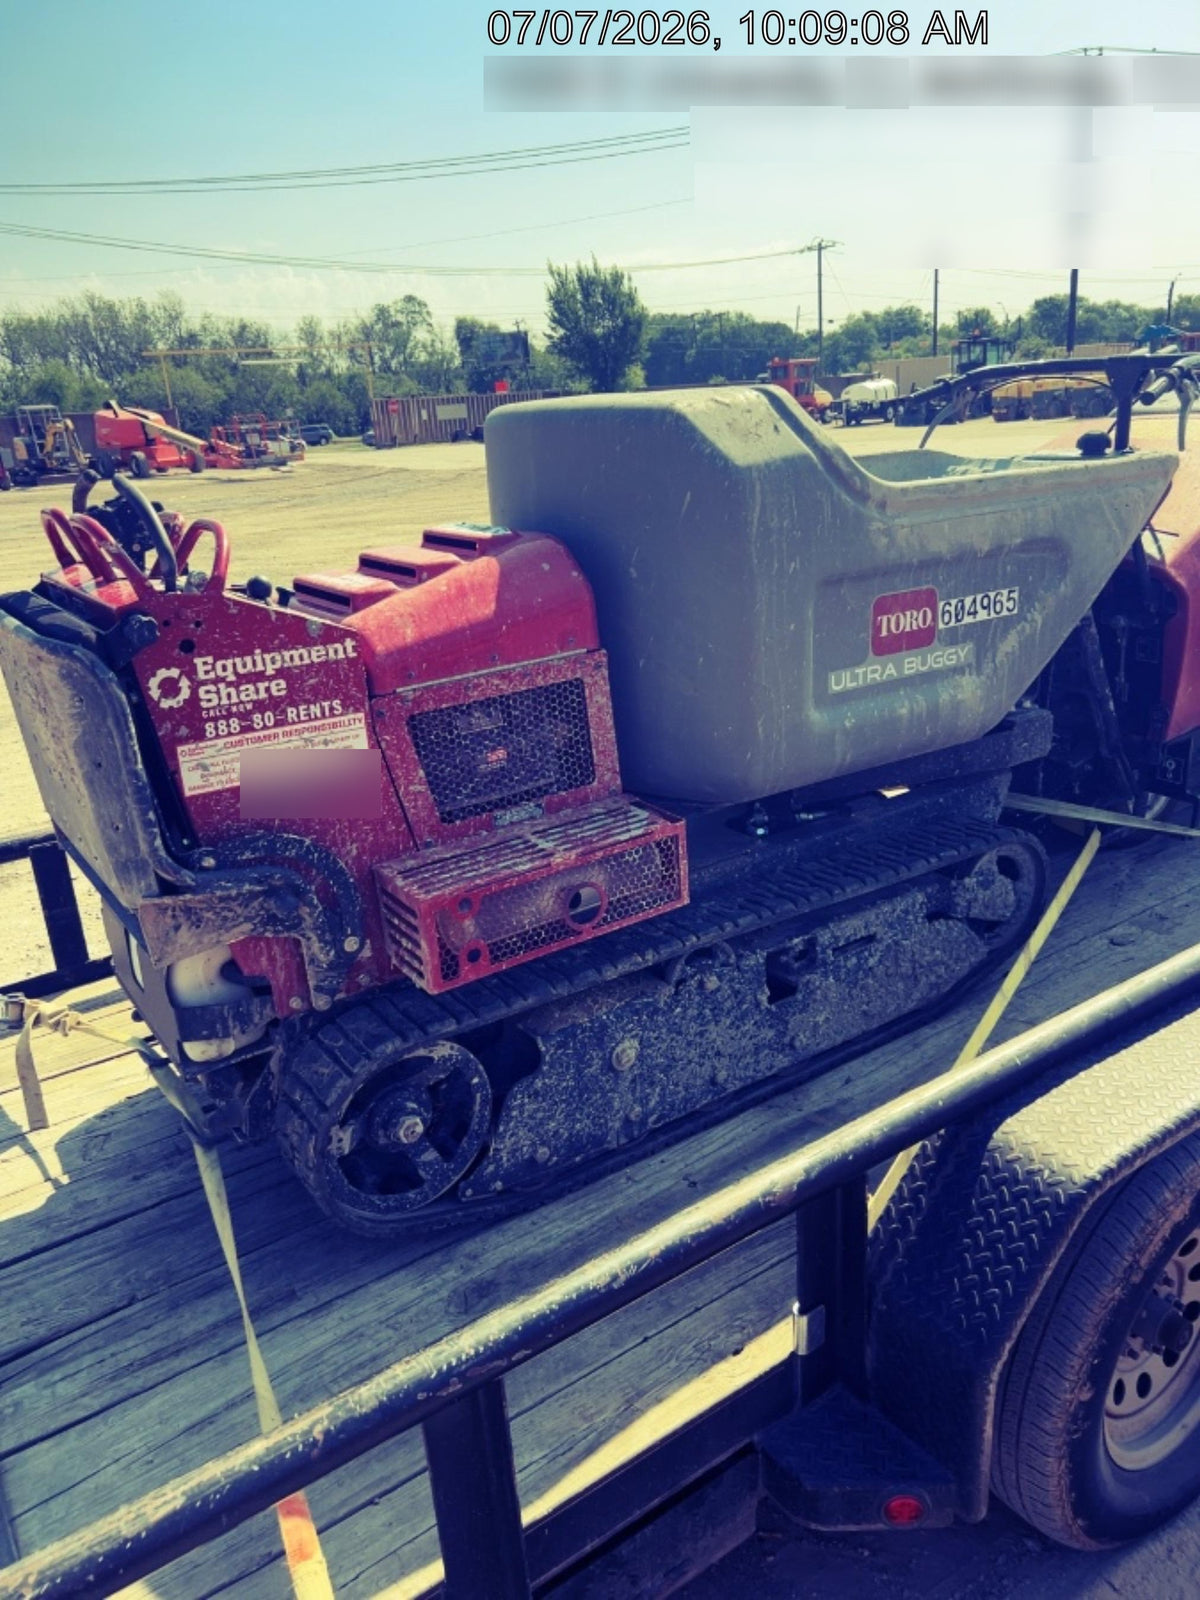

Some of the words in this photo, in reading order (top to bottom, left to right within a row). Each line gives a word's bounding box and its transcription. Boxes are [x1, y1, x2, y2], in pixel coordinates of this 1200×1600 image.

[878, 607, 932, 637] TORO
[193, 637, 358, 682] Equipment
[831, 663, 897, 691] ULTRA
[904, 646, 970, 675] BUGGY
[198, 678, 288, 709] Share
[202, 707, 228, 719] CALL
[204, 699, 343, 739] 888-80-RENTS
[223, 732, 280, 749] CUSTOMER
[282, 717, 363, 739] RESPONSIBILITY
